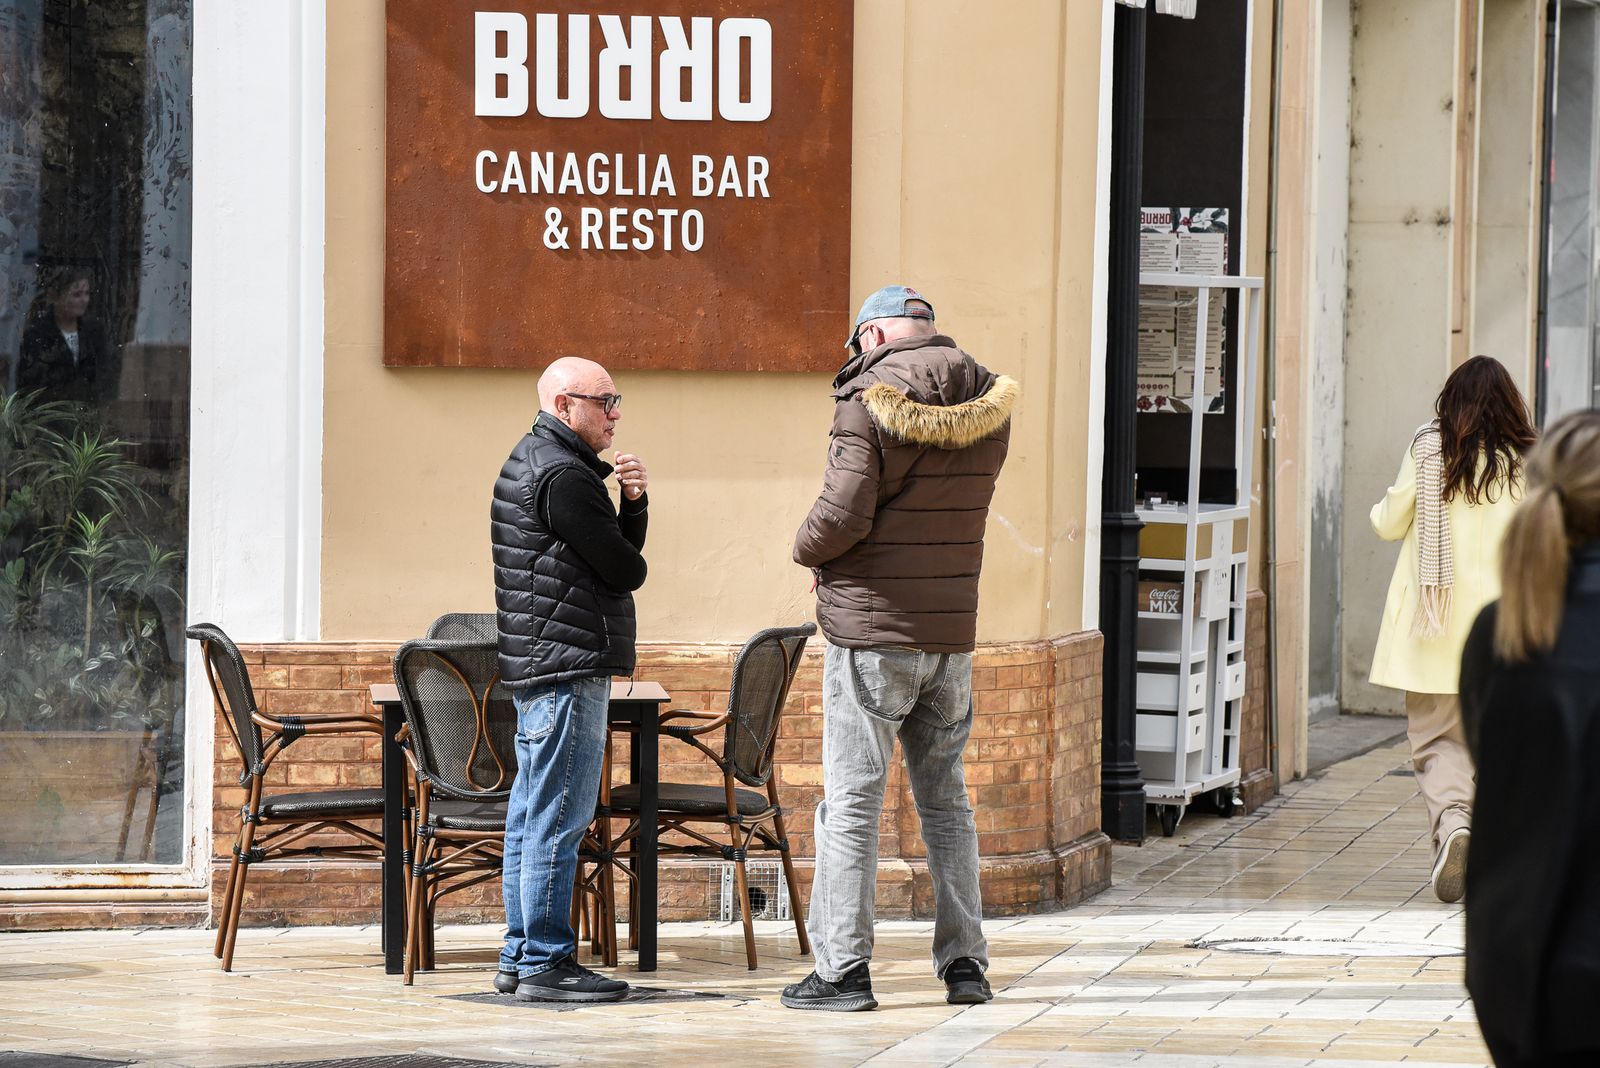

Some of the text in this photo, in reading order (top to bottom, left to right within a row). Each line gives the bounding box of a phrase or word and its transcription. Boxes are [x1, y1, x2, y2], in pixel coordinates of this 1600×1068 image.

[474, 11, 773, 122] BURRO
[475, 149, 770, 198] CANAGLIA BAR
[543, 206, 704, 252] & RESTO
[1140, 212, 1171, 225] BURRO
[1149, 600, 1178, 613] MIX
